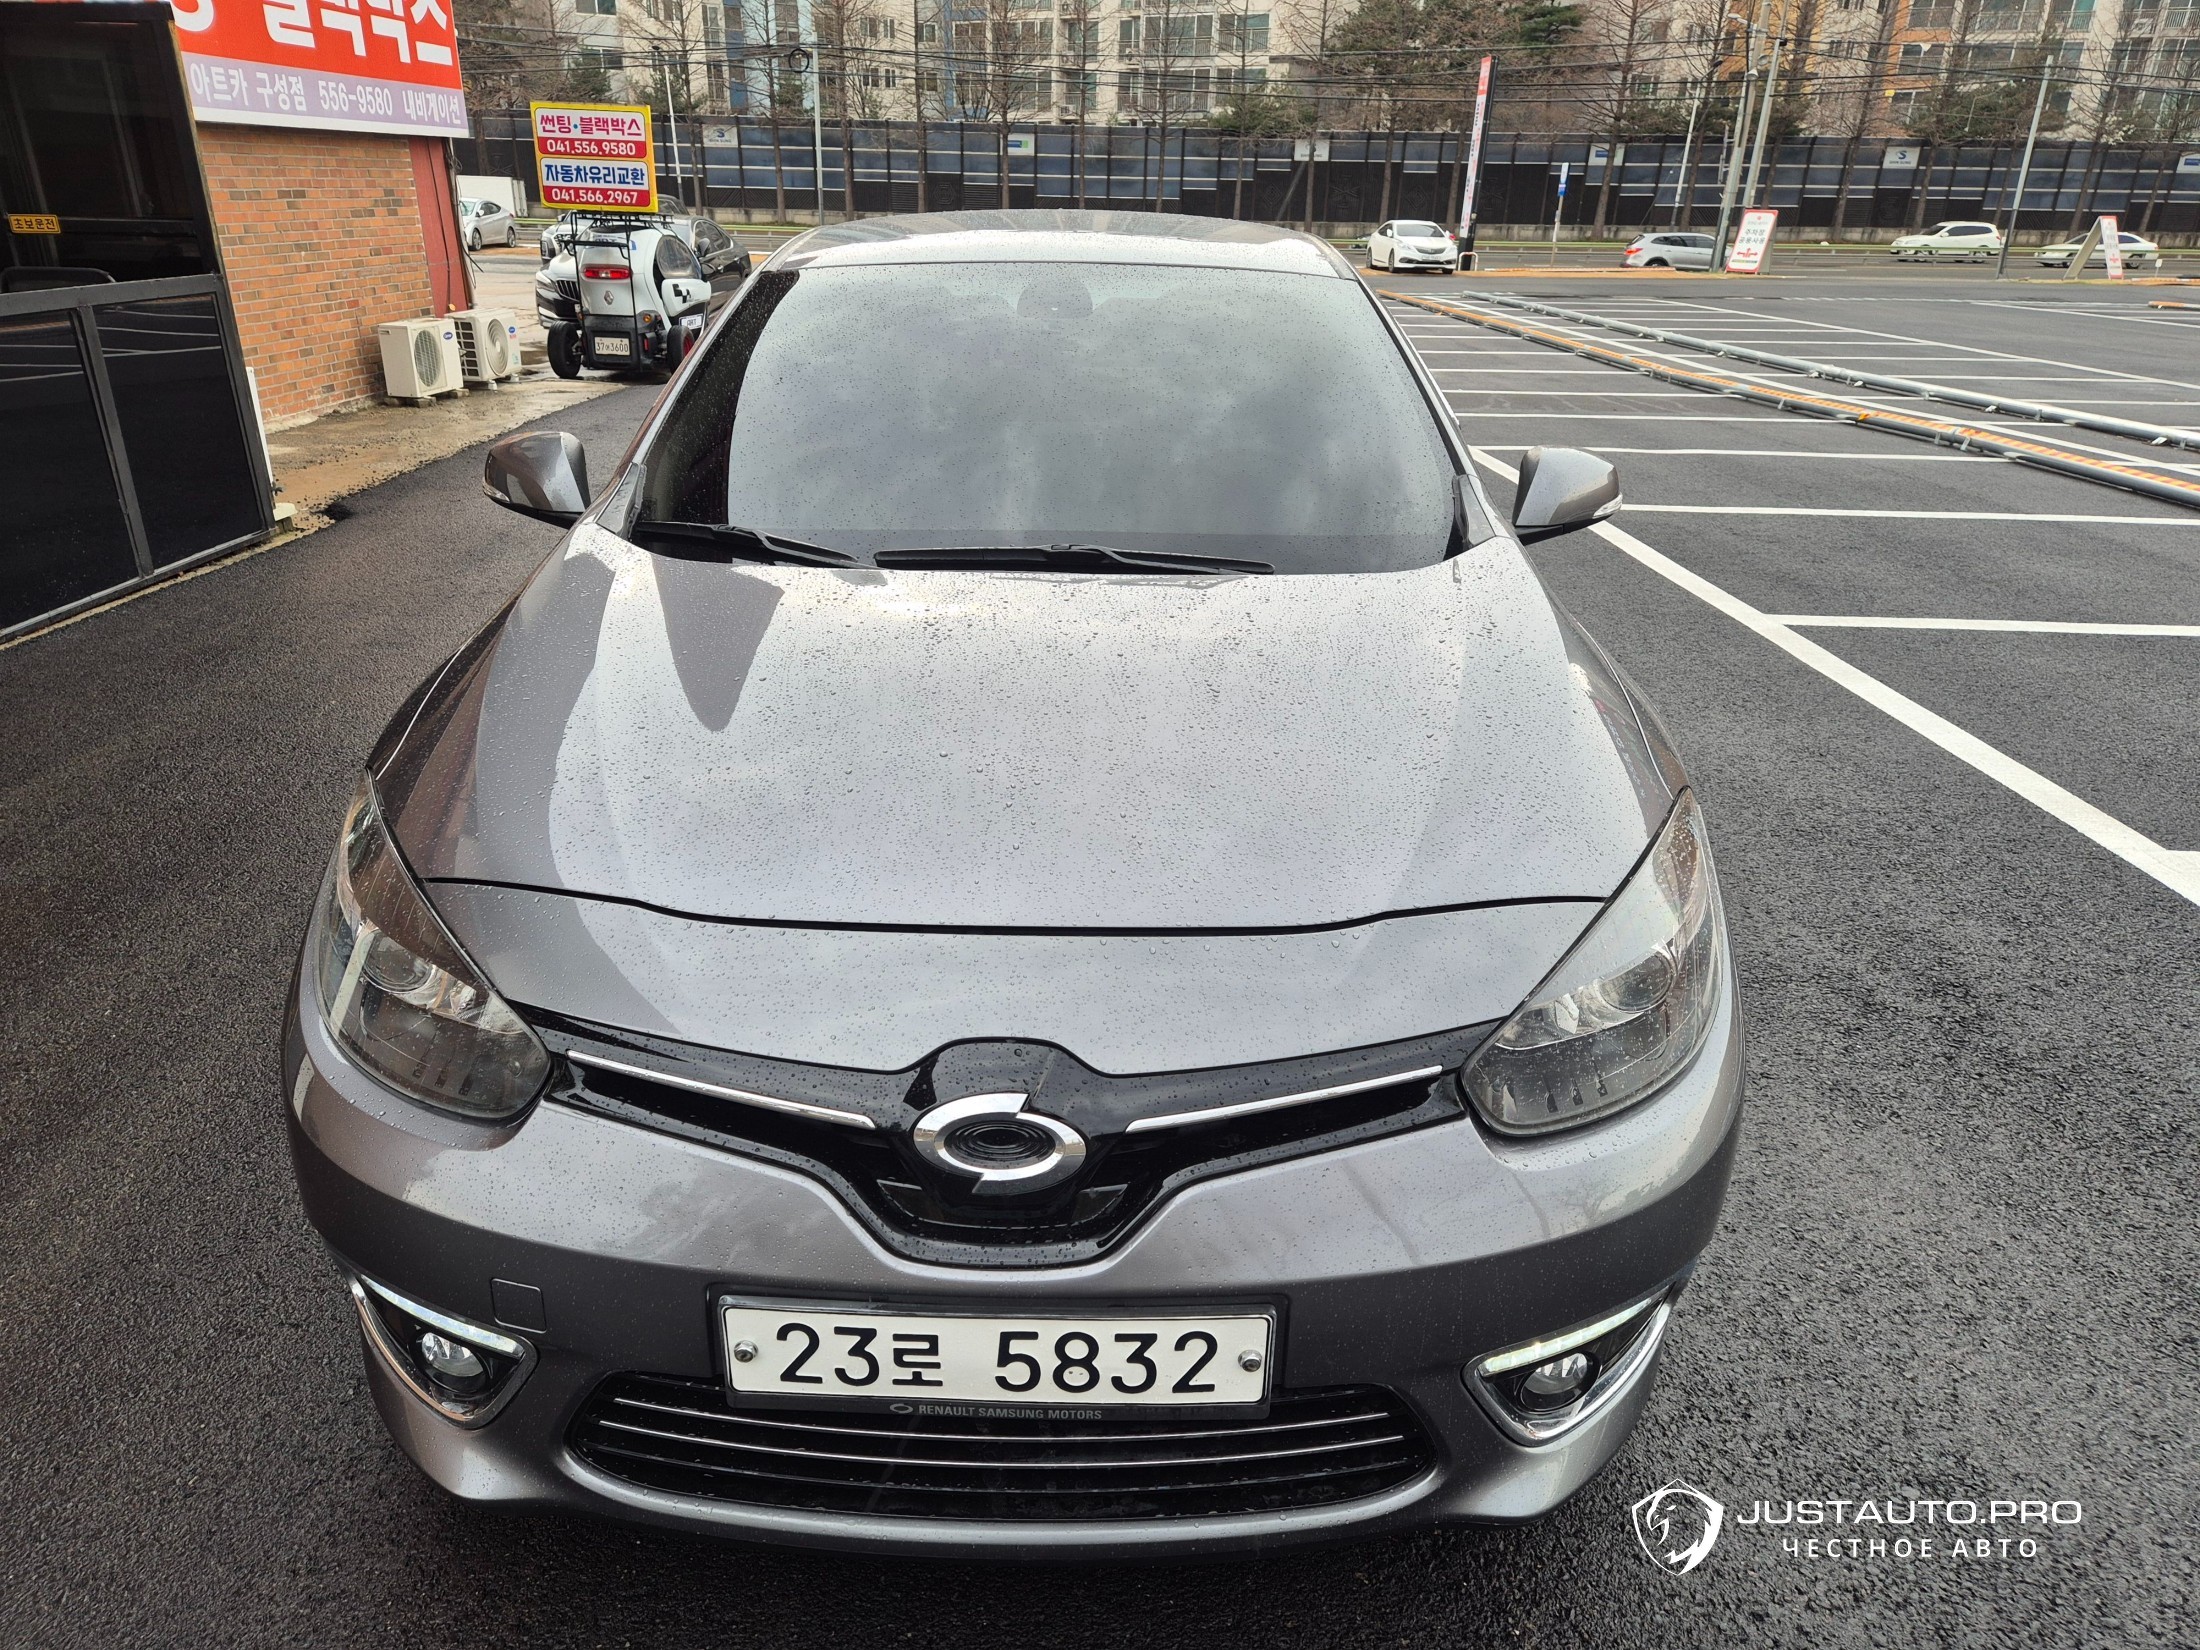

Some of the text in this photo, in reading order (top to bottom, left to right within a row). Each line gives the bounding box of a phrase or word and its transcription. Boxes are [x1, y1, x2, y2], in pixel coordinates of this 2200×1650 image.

[190, 62, 462, 125] 아트카 구성점 556-9580 내비게이션
[546, 139, 636, 155] 041.556.9580
[544, 164, 645, 186] 자동차유리교환
[551, 188, 638, 204] 041.566.2967
[13, 217, 56, 230] 초보운전
[777, 1323, 1217, 1394] 23로 5832
[918, 1404, 1102, 1420] RENAULT SAMSUNG MOTORS
